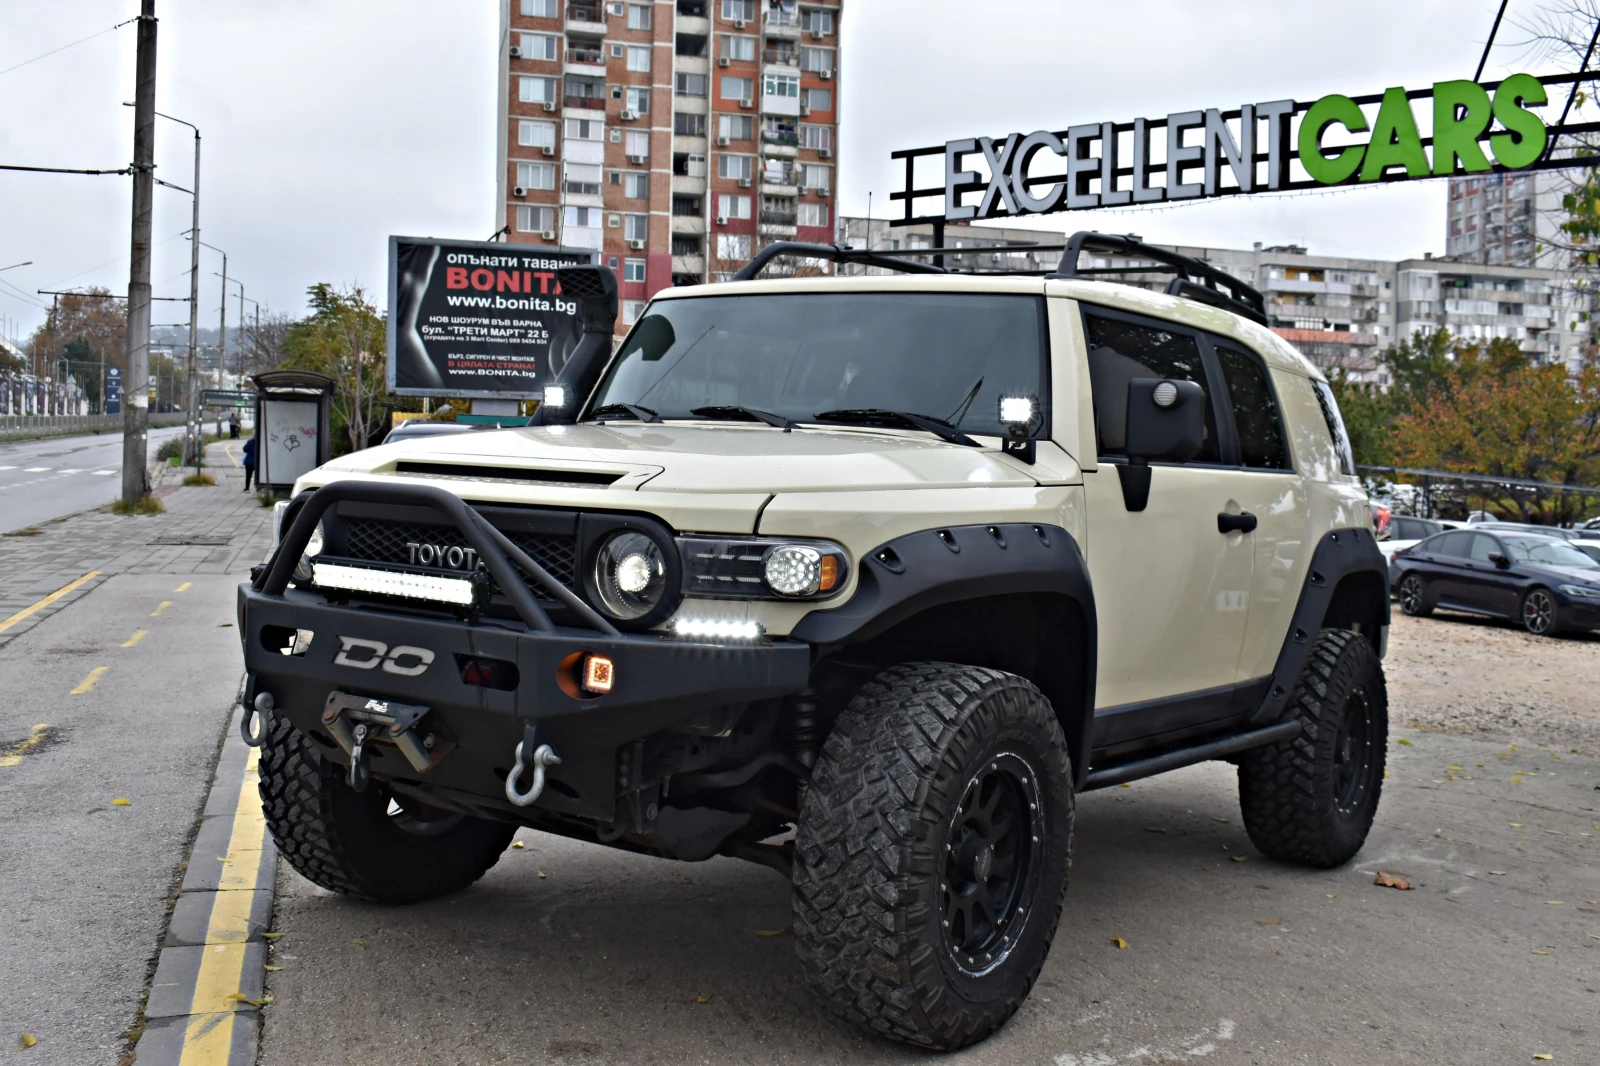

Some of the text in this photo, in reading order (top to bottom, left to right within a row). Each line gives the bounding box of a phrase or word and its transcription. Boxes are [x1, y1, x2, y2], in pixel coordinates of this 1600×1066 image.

[945, 73, 1548, 220] EXCELLENT CARS
[447, 253, 518, 268] опънати
[446, 267, 563, 295] BONIT
[447, 295, 577, 316] www.bonita.bg
[429, 315, 449, 323] НОВ
[450, 316, 490, 325] ШОУРУМ
[512, 320, 543, 328] ВАРНА
[421, 325, 445, 335] бул.
[527, 330, 540, 338] 22
[542, 330, 549, 339] Б
[496, 362, 535, 370] СТРАНА!
[448, 369, 536, 378] www.BONITA.bg
